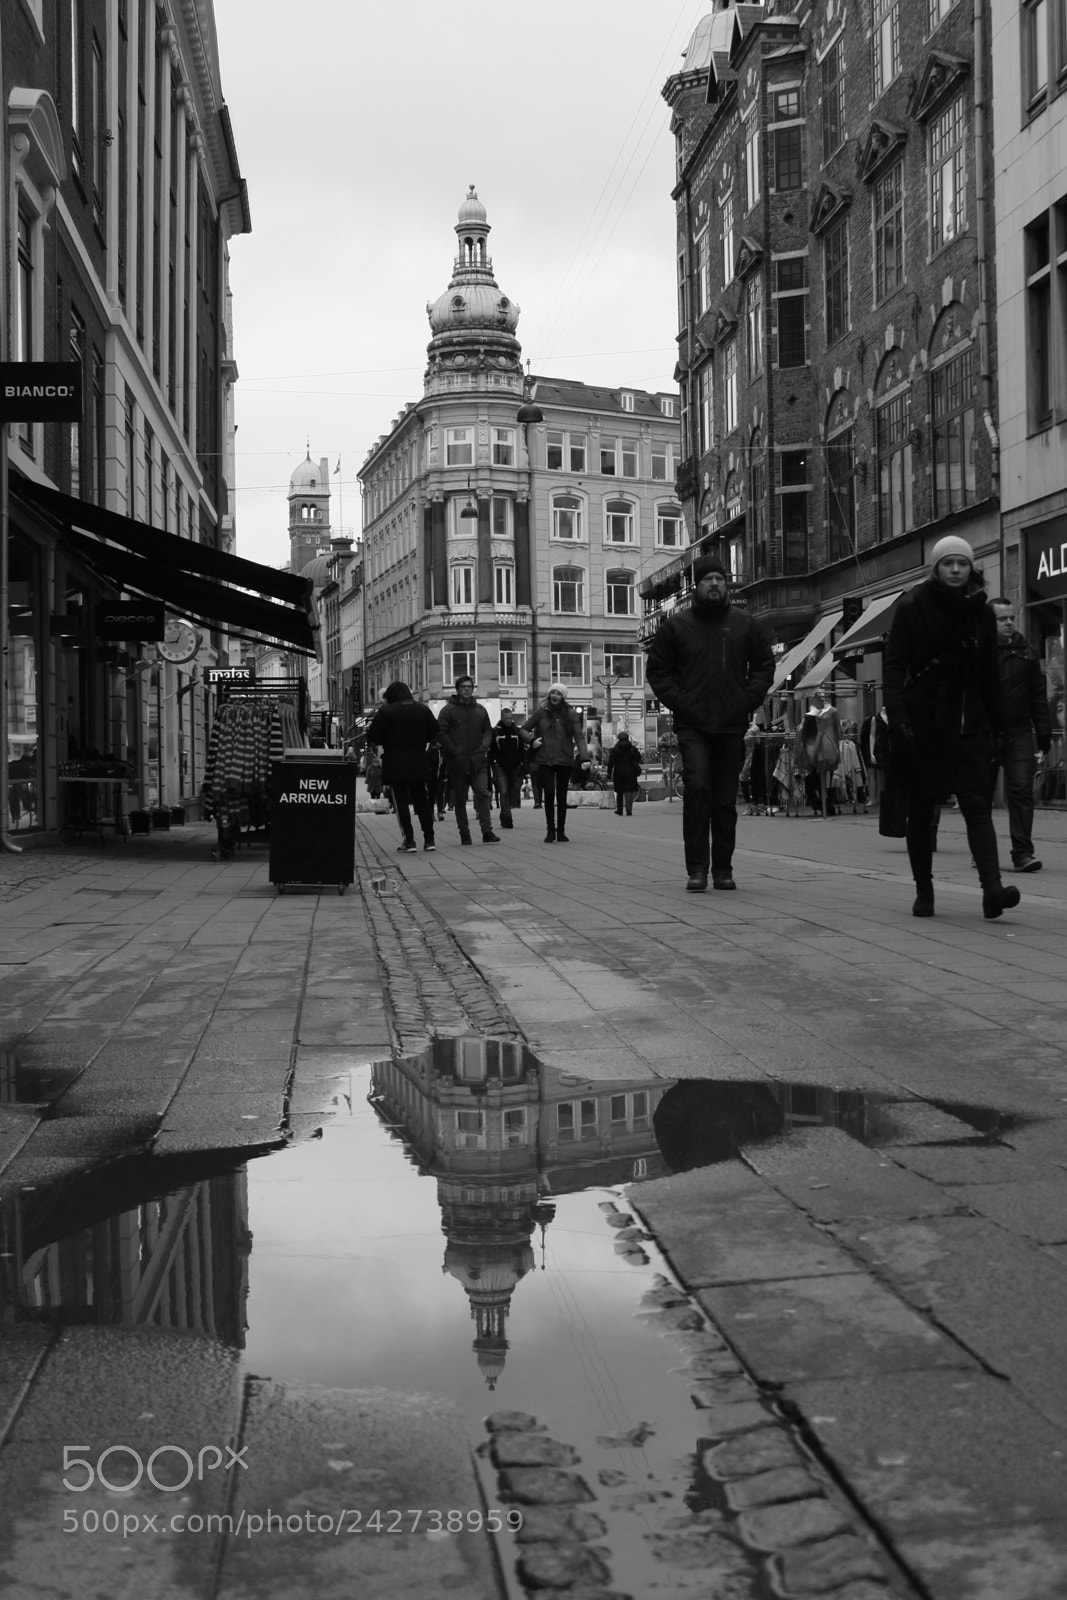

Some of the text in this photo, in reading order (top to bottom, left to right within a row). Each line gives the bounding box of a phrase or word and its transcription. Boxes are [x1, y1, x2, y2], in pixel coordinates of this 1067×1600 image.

[105, 615, 156, 624] pieces
[209, 667, 250, 682] matas
[299, 779, 329, 790] NEW
[280, 792, 347, 805] ARRIVALS!
